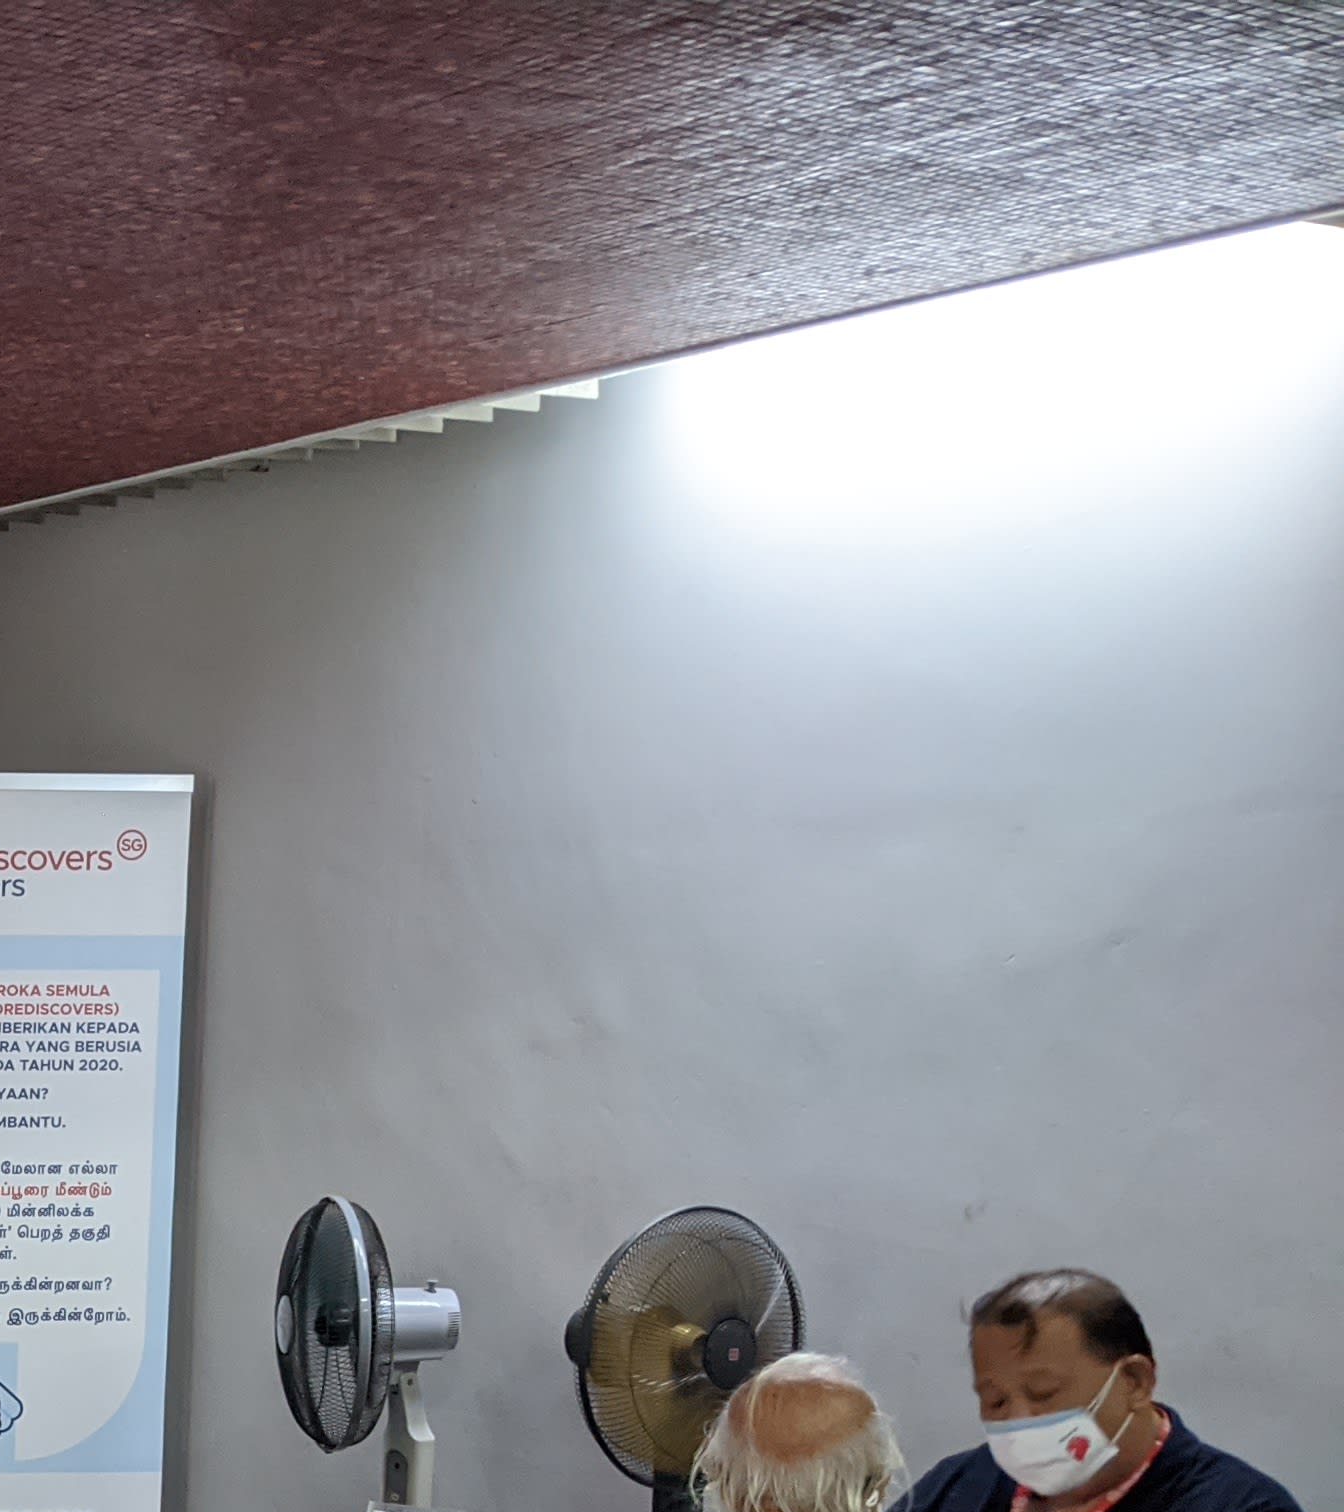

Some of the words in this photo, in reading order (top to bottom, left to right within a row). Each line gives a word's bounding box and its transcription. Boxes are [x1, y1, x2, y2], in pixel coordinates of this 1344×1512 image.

[121, 837, 143, 851] SG
[46, 985, 110, 996] SEMULA
[76, 1022, 139, 1033] KEPADA
[26, 1041, 69, 1052] YANG
[75, 1041, 141, 1052] BERUSIA
[20, 1059, 74, 1071] TAHUN
[79, 1059, 123, 1071] 2020.
